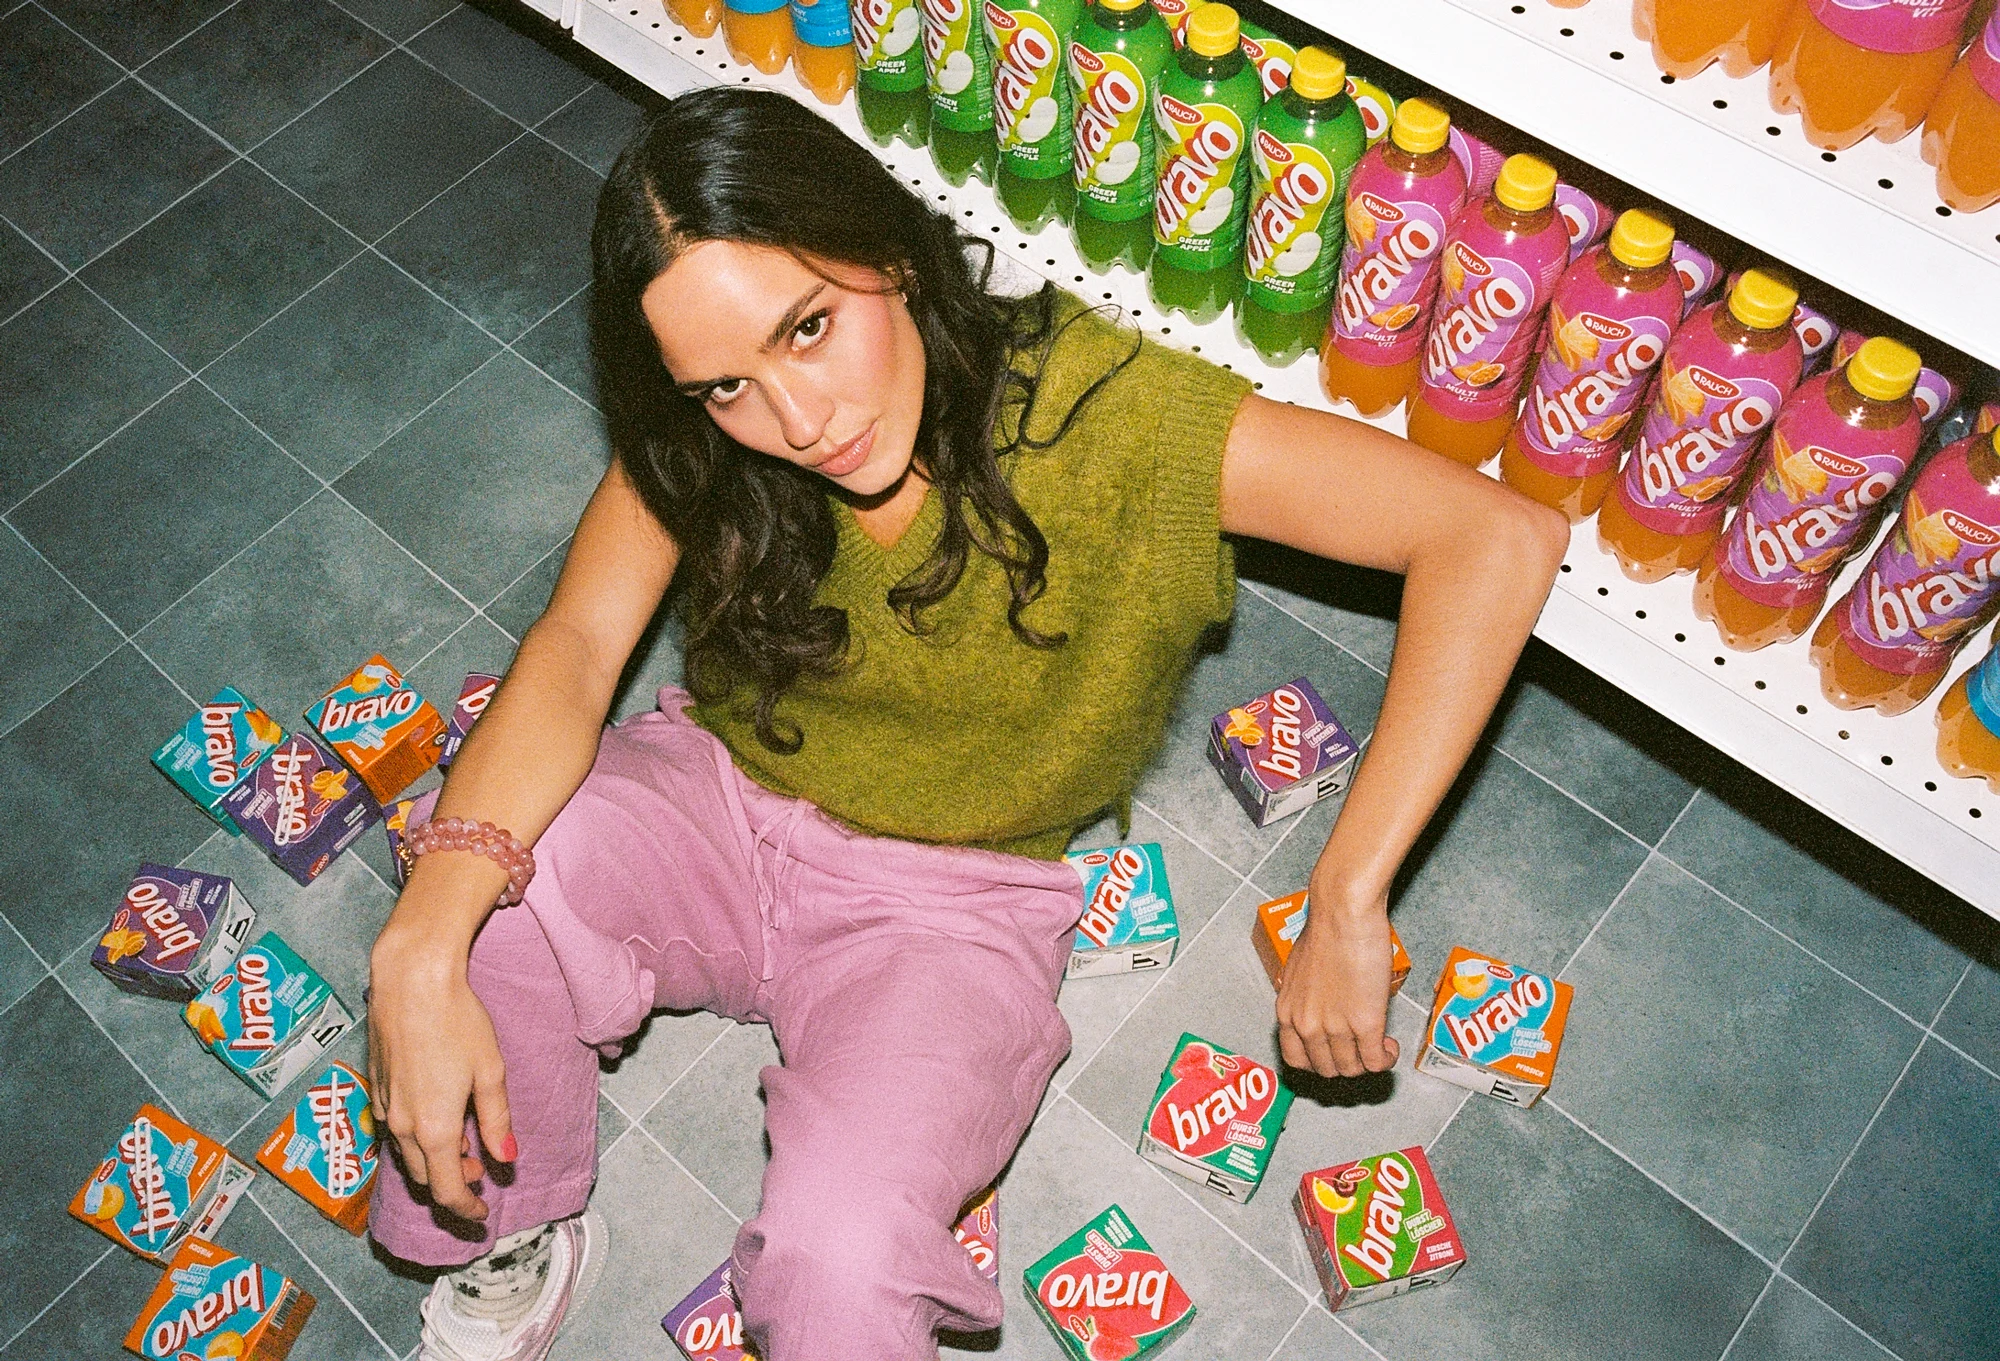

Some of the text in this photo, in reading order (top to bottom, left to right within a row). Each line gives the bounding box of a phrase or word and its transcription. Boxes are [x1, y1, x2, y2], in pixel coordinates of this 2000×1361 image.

[1912, 6, 1943, 18] VIT
[876, 60, 906, 68] GREEN
[1078, 50, 1099, 70] RAUCH
[1168, 103, 1197, 122] RAUCH
[1011, 144, 1039, 154] GREEN
[1012, 151, 1039, 160] APPLE
[1264, 139, 1288, 160] RAUCH
[1088, 184, 1118, 198] GREEN
[1089, 192, 1117, 204] APPLE
[1370, 201, 1399, 220] RAUCH
[1178, 236, 1212, 246] GREEN
[1180, 243, 1210, 252] APPLE
[1460, 254, 1487, 274] RAUCH
[1263, 275, 1296, 288] GREEN
[1264, 283, 1295, 294] APPLE
[1363, 332, 1398, 342] MULTI
[1592, 320, 1625, 338] RAUCH
[1378, 340, 1396, 348] VIT
[1446, 382, 1479, 397] MULTI
[1536, 334, 1663, 450] bravo
[1700, 376, 1734, 396] RAUCH
[1458, 394, 1477, 402] VIT
[1640, 396, 1772, 503] bravo
[1821, 454, 1862, 476] RAUCH
[1668, 502, 1703, 512] MULTI
[1746, 472, 1897, 578] bravo
[1954, 520, 1995, 543] RAUCH
[322, 690, 418, 734] bravo
[1258, 688, 1301, 780] bravo
[200, 706, 240, 788] bravo
[1080, 848, 1144, 946] bravo
[128, 882, 200, 961] bravo
[231, 954, 276, 1048] bravo
[1449, 974, 1547, 1059] bravo
[1168, 1068, 1270, 1152] bravo
[1228, 1131, 1264, 1147] LÖSCHER
[1231, 1123, 1258, 1135] DURST
[1345, 1158, 1410, 1280] bravo
[1406, 1212, 1430, 1229] DURST
[1410, 1218, 1443, 1239] LÖSCHER
[1086, 1245, 1111, 1269] DURST
[1087, 1232, 1119, 1262] LÖSCHER
[1048, 1270, 1168, 1320] bravo
[151, 1262, 260, 1357] bravo
[1072, 1318, 1087, 1336] RAUCH
